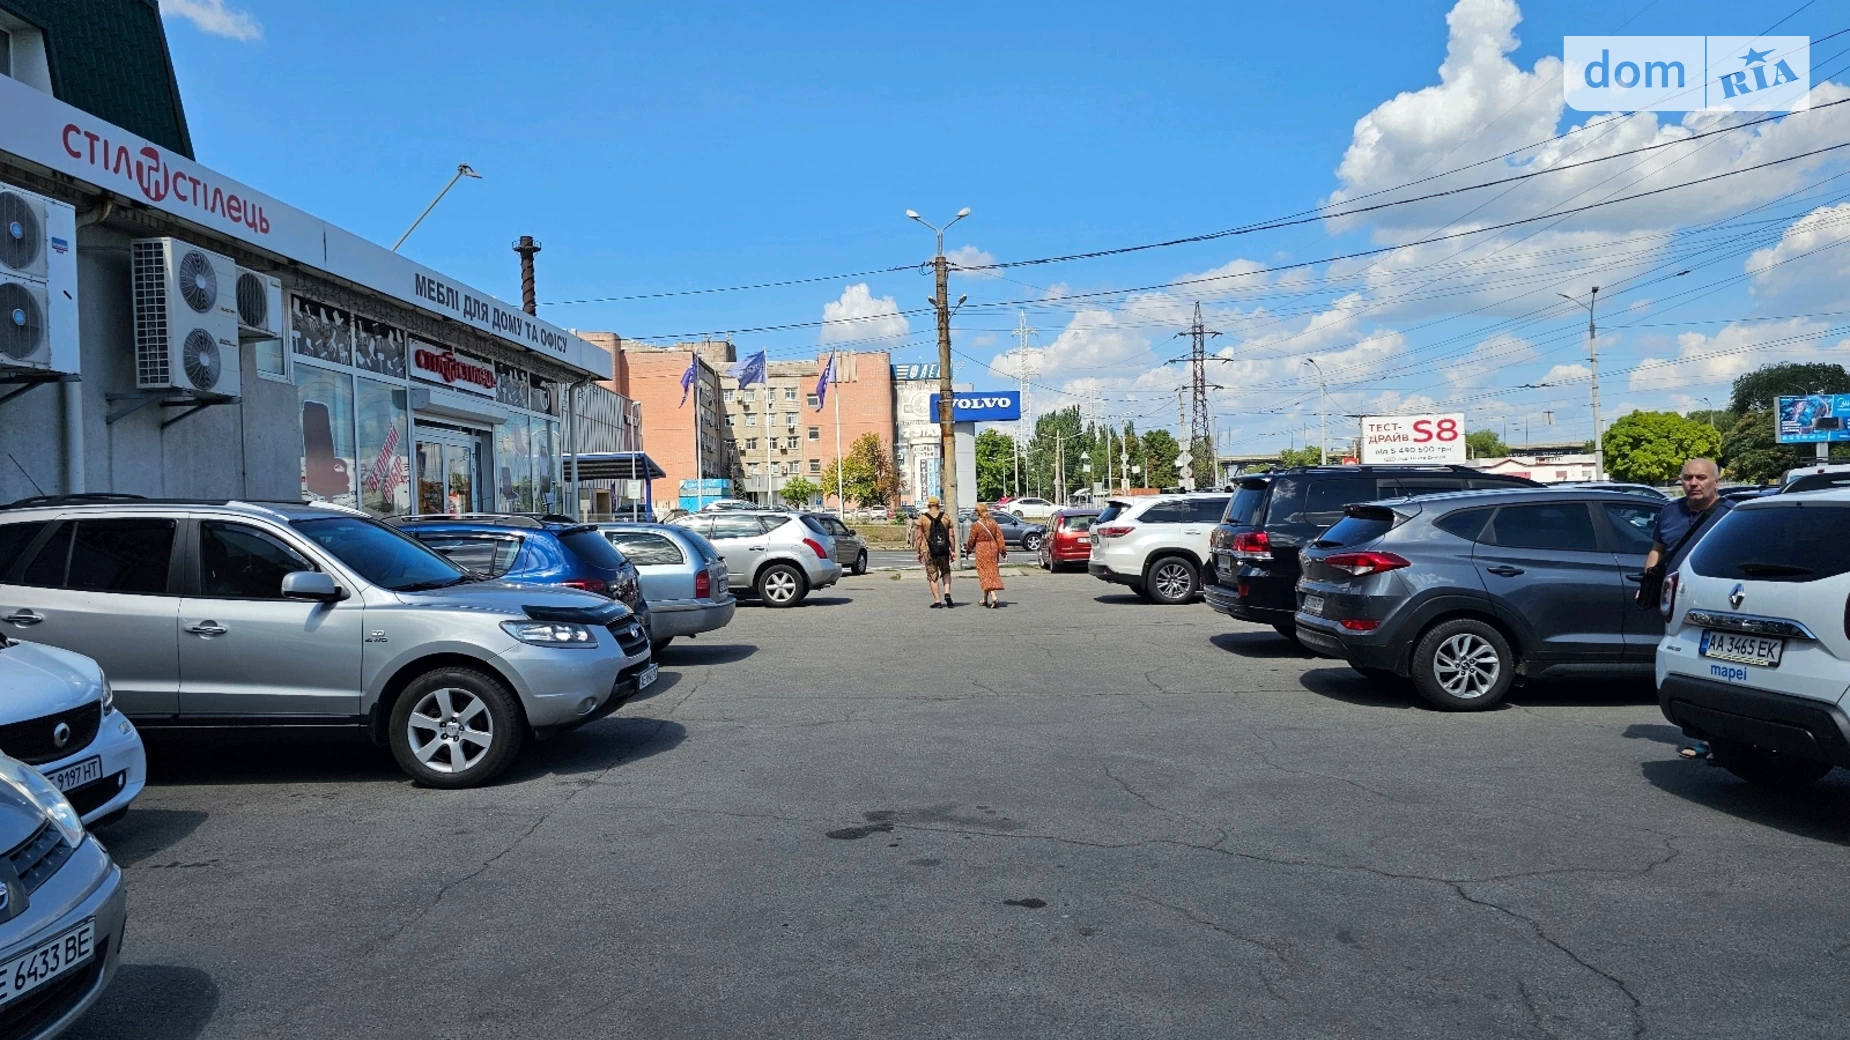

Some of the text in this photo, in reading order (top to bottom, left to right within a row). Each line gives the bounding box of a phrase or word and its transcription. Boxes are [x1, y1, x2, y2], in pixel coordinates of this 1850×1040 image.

[415, 272, 568, 353] МЕБЛІ ДЛЯ ДОМУ ТА ОФІСУ
[1368, 423, 1410, 445] ТЕСТ- ДРАЙВ
[1412, 418, 1459, 443] S8
[1708, 634, 1724, 652] AA
[1727, 636, 1755, 655] 3465
[1757, 641, 1778, 659] EK
[1710, 664, 1747, 681] mapei
[57, 766, 81, 790] 9197
[83, 760, 98, 780] HT
[14, 943, 60, 991] 6433
[64, 927, 91, 965] BE
